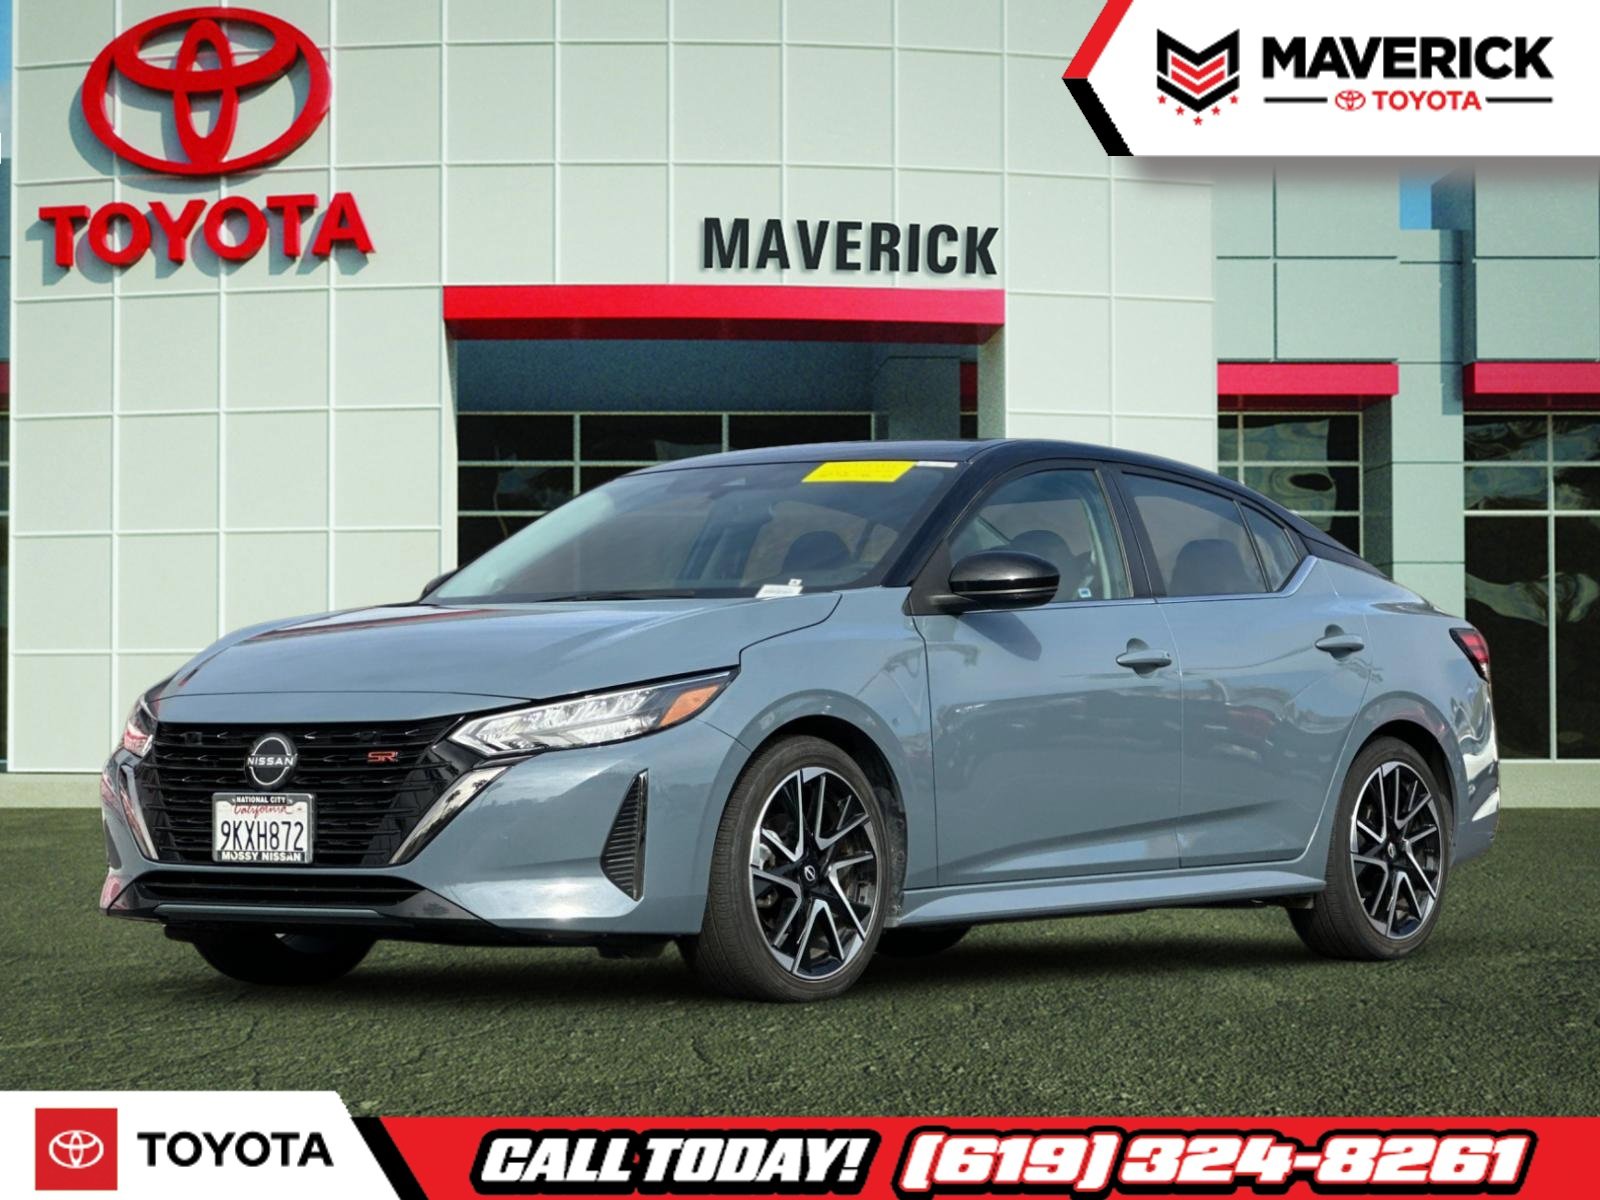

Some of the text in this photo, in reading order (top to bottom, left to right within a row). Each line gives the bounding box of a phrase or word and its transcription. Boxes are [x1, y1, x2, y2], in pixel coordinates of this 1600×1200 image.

[39, 192, 375, 268] TOYOTA
[703, 217, 999, 275] MAVERICK
[246, 756, 294, 767] NISSAN
[367, 751, 397, 762] SR
[236, 796, 286, 804] NATIONAL CITY
[232, 804, 293, 817] California
[220, 820, 304, 852] 9KXH872
[221, 852, 301, 861] MOSSY NISSAN
